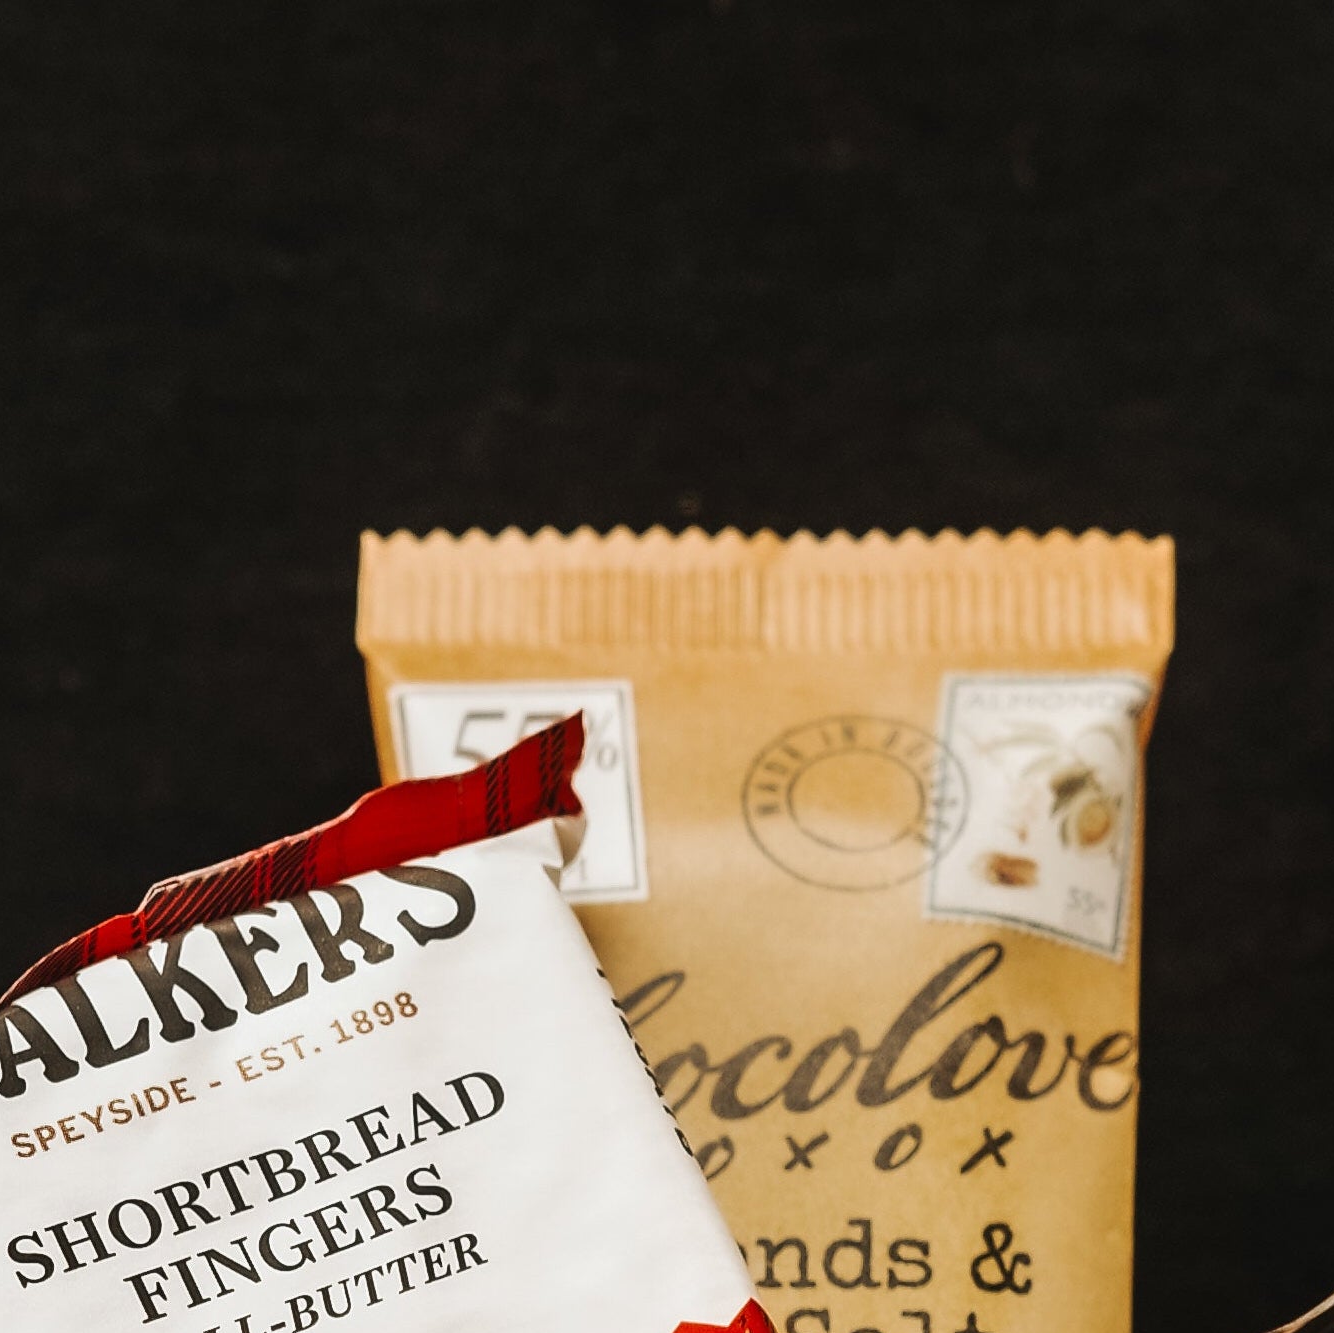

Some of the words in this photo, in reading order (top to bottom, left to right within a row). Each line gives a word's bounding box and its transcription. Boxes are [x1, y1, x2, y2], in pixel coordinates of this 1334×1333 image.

[10, 1076, 197, 1158] SPEYSIDE
[235, 1036, 322, 1083] EST.
[329, 991, 420, 1044] 1898
[6, 1071, 506, 1288] SHORTBREAD
[123, 1164, 454, 1325] FINGERS
[737, 1219, 933, 1290] nds
[970, 1222, 1033, 1295] &
